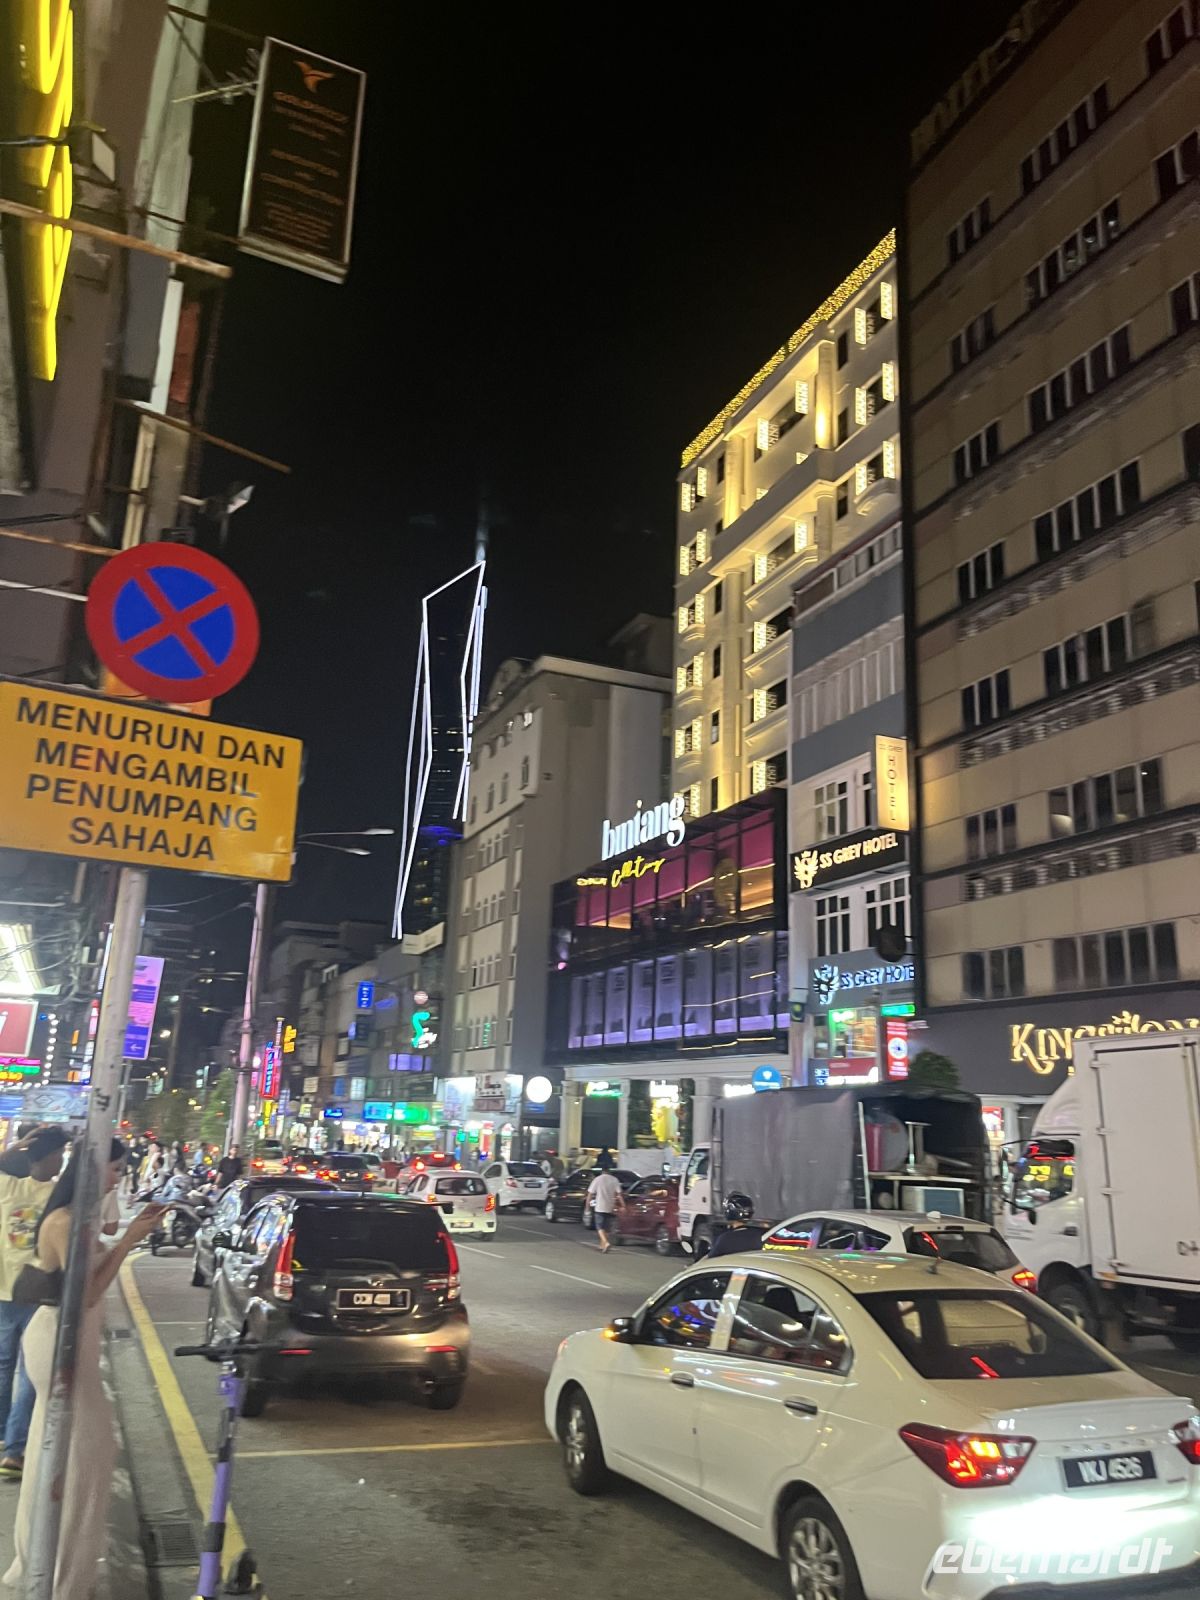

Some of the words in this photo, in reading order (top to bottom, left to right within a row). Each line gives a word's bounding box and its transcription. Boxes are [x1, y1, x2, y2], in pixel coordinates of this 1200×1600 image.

[16, 696, 204, 755] MENURUN
[217, 735, 285, 769] DAN
[35, 738, 258, 799] MENGAMBIL
[25, 773, 258, 832] PENUMPANG
[68, 816, 215, 861] SAHAJA
[819, 852, 833, 869] SS
[833, 842, 862, 864] GREY
[863, 832, 899, 856] HOTEL
[886, 962, 915, 984] HOTE
